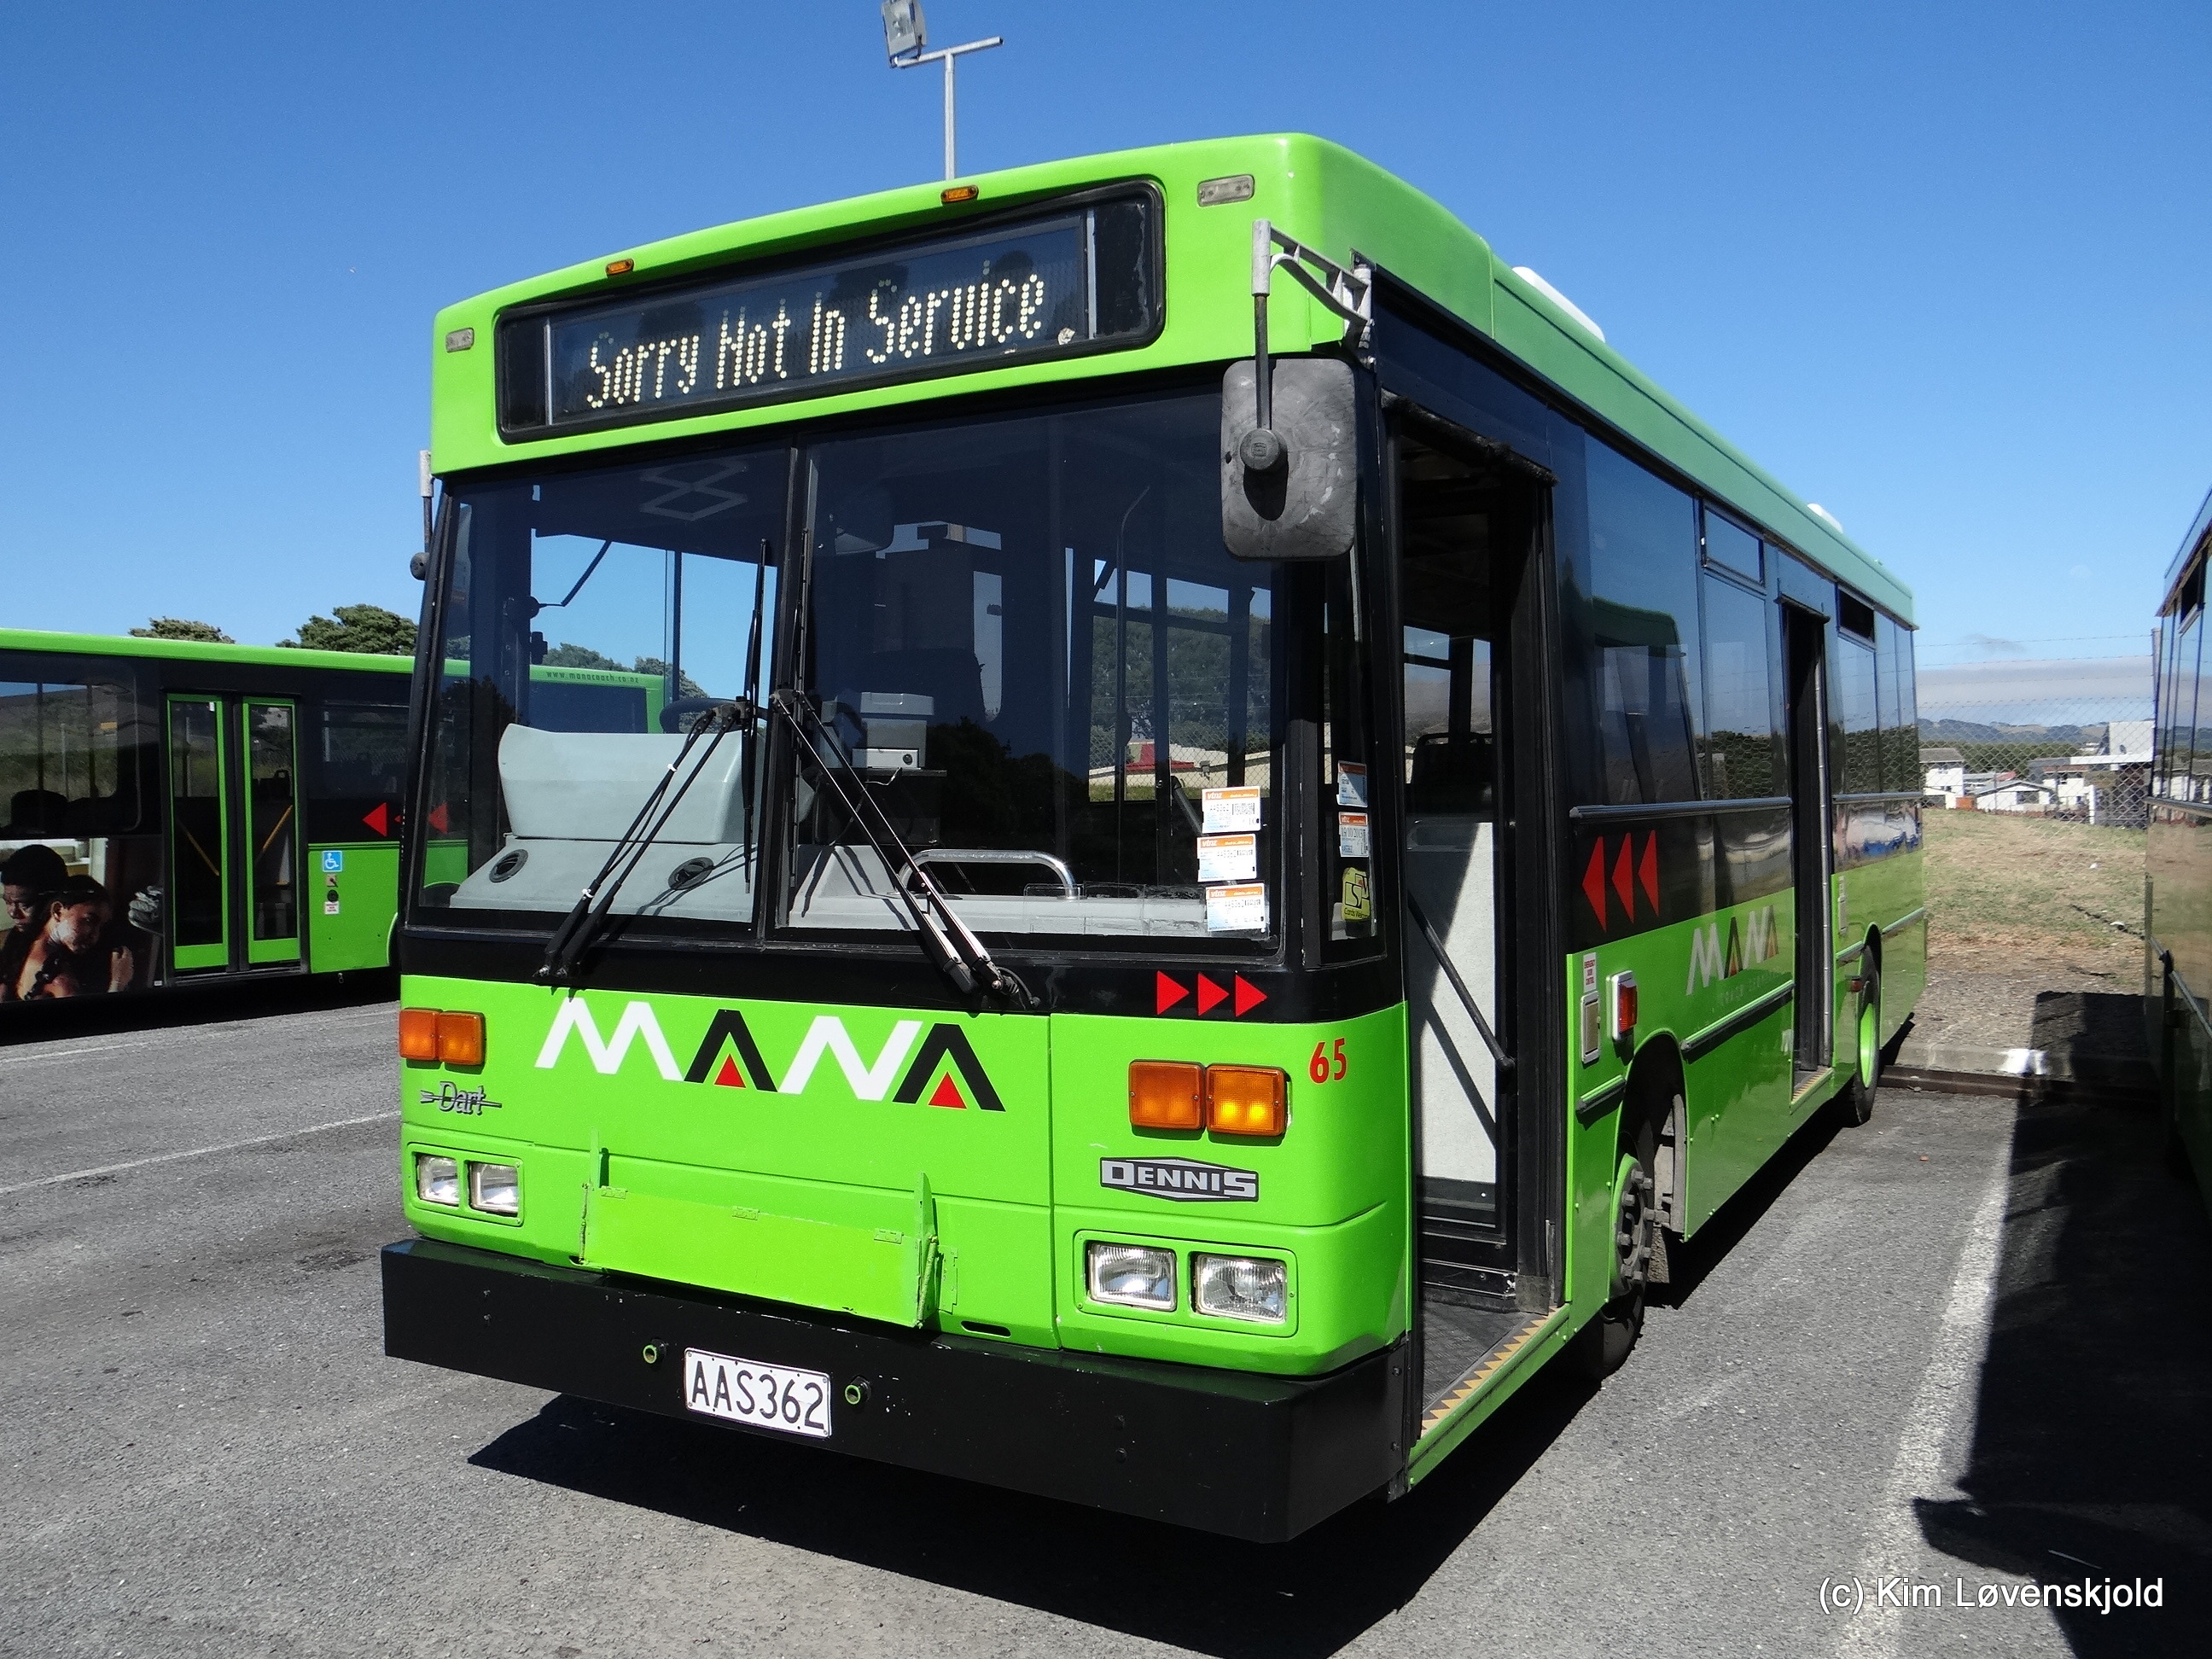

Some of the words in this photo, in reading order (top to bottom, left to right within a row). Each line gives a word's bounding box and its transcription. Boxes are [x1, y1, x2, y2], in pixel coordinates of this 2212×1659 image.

[586, 331, 700, 408] Sorry
[715, 299, 791, 388] Not
[809, 291, 846, 374] In
[866, 259, 1045, 364] Service
[1686, 905, 1779, 996] MANA
[534, 996, 1007, 1112] MANA
[1308, 1038, 1348, 1084] 65
[439, 1080, 486, 1115] Dart
[1101, 1160, 1257, 1199] DENNIS
[691, 1360, 825, 1430] AAS362
